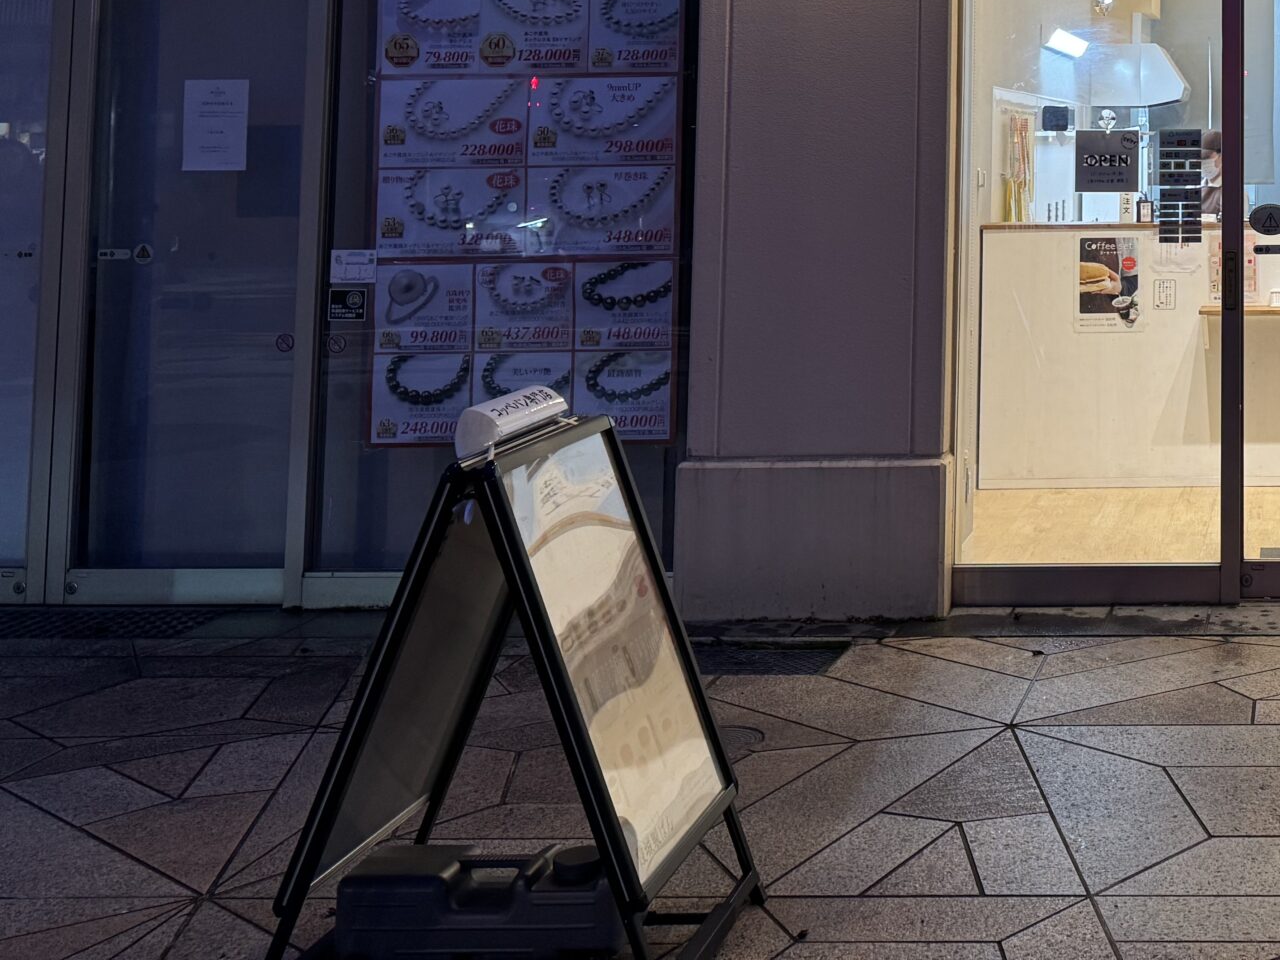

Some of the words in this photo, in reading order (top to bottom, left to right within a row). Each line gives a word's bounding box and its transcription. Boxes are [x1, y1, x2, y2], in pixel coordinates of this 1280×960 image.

[1085, 154, 1129, 167] OPEN
[491, 174, 517, 189] 花珠
[1085, 241, 1116, 251] Coffee
